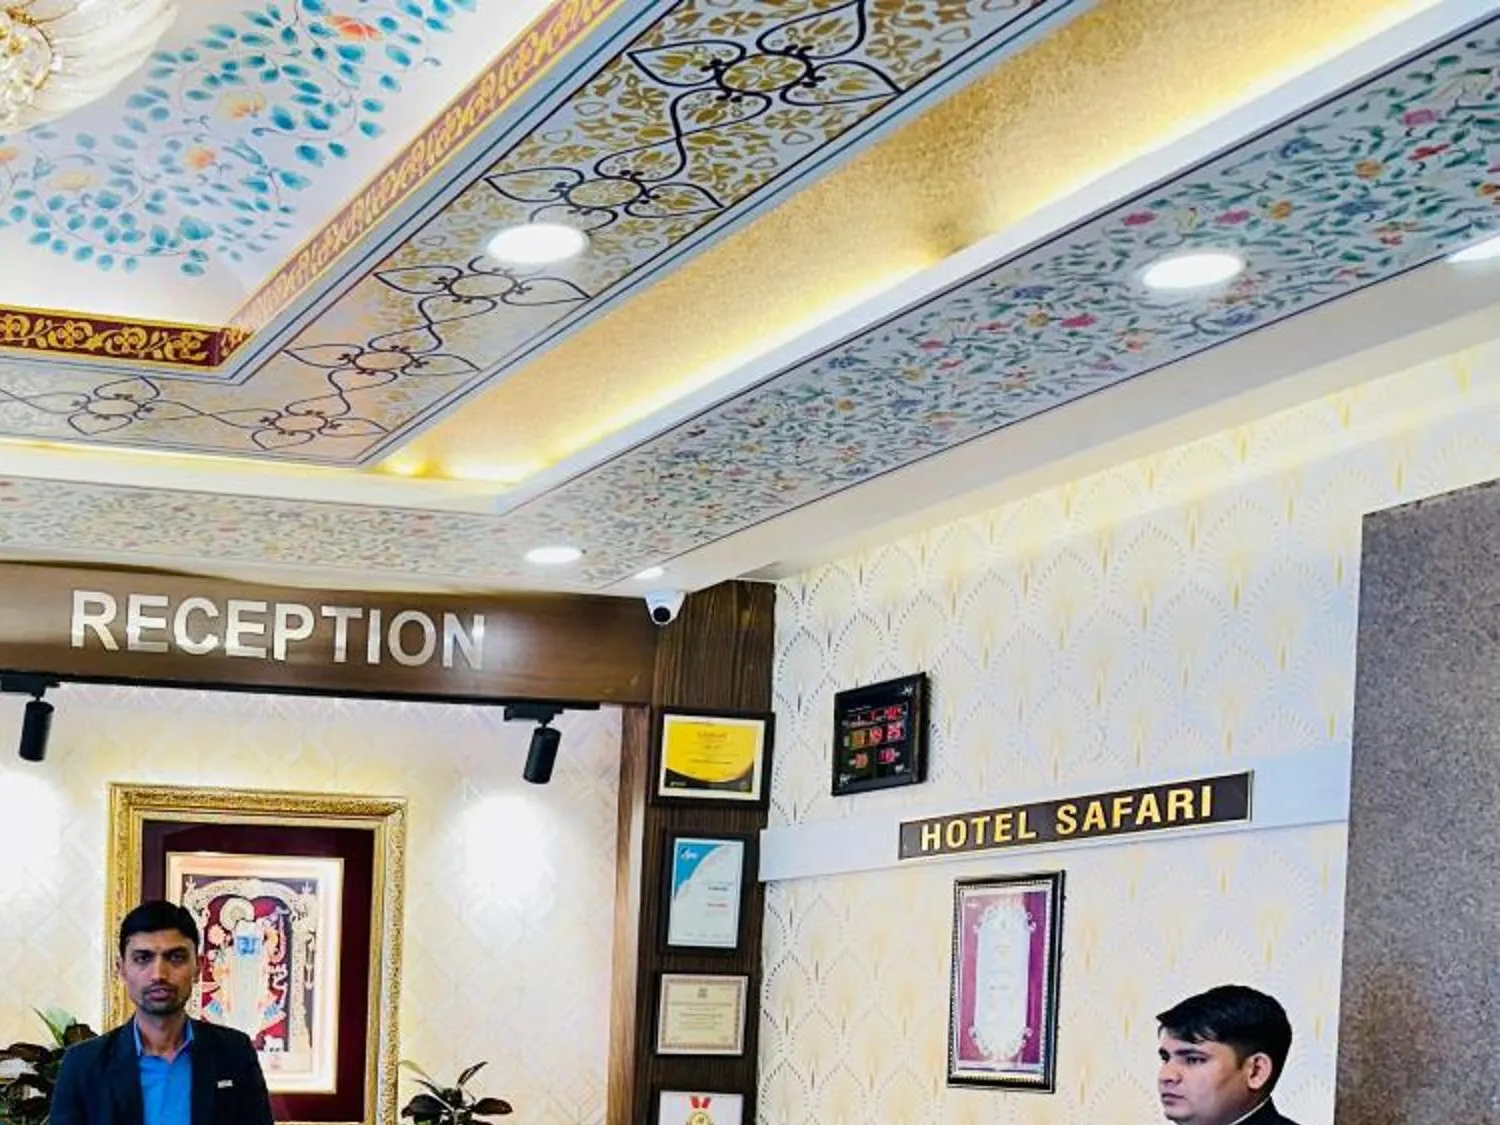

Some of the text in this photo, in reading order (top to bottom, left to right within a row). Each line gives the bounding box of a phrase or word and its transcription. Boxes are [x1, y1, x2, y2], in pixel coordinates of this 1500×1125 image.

[71, 590, 485, 670] RECEPTION
[921, 785, 1213, 851] HOTEL SAFARI
